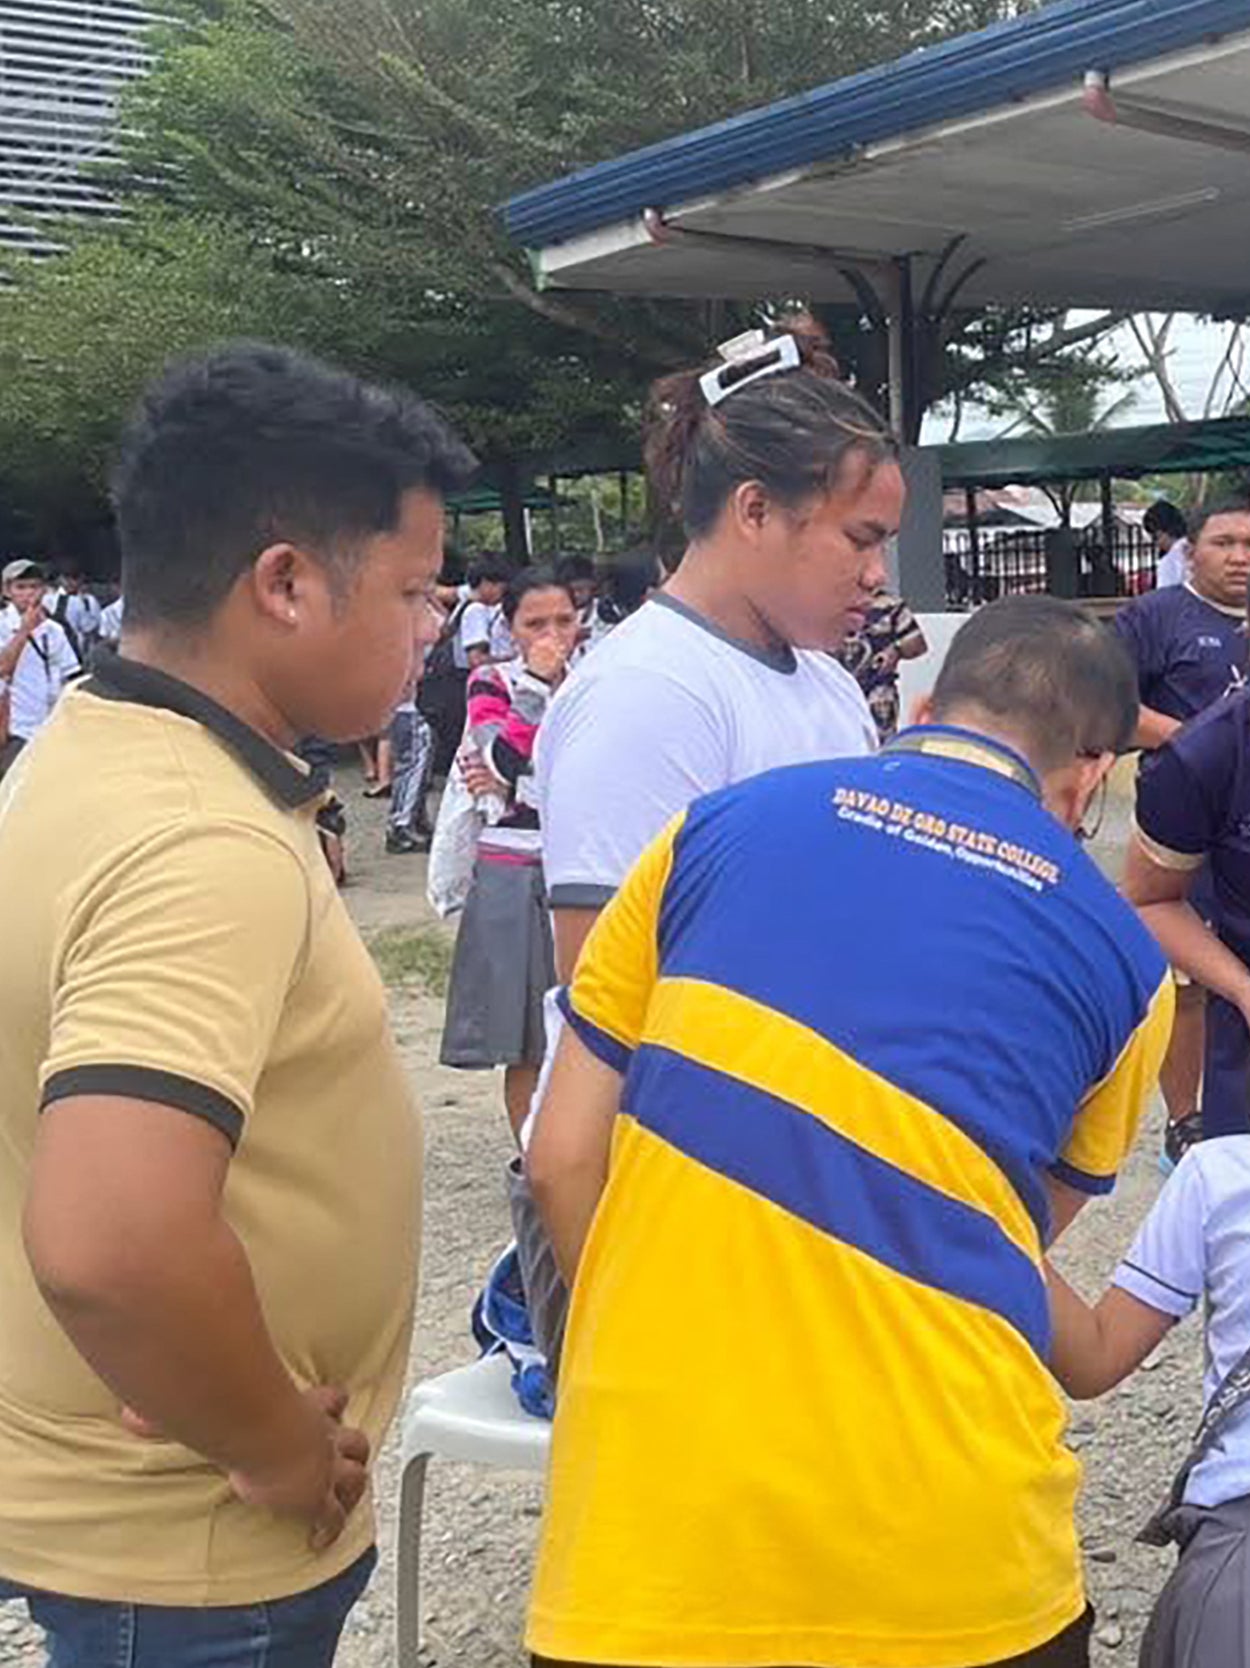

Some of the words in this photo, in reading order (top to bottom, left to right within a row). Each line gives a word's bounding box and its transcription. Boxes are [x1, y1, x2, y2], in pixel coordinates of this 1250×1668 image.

[832, 788, 891, 815] DAVAO
[889, 802, 914, 826] DE
[914, 812, 947, 837] ORO
[946, 824, 999, 854] STATE
[997, 841, 1059, 884] COLLEGE
[885, 824, 903, 836] of
